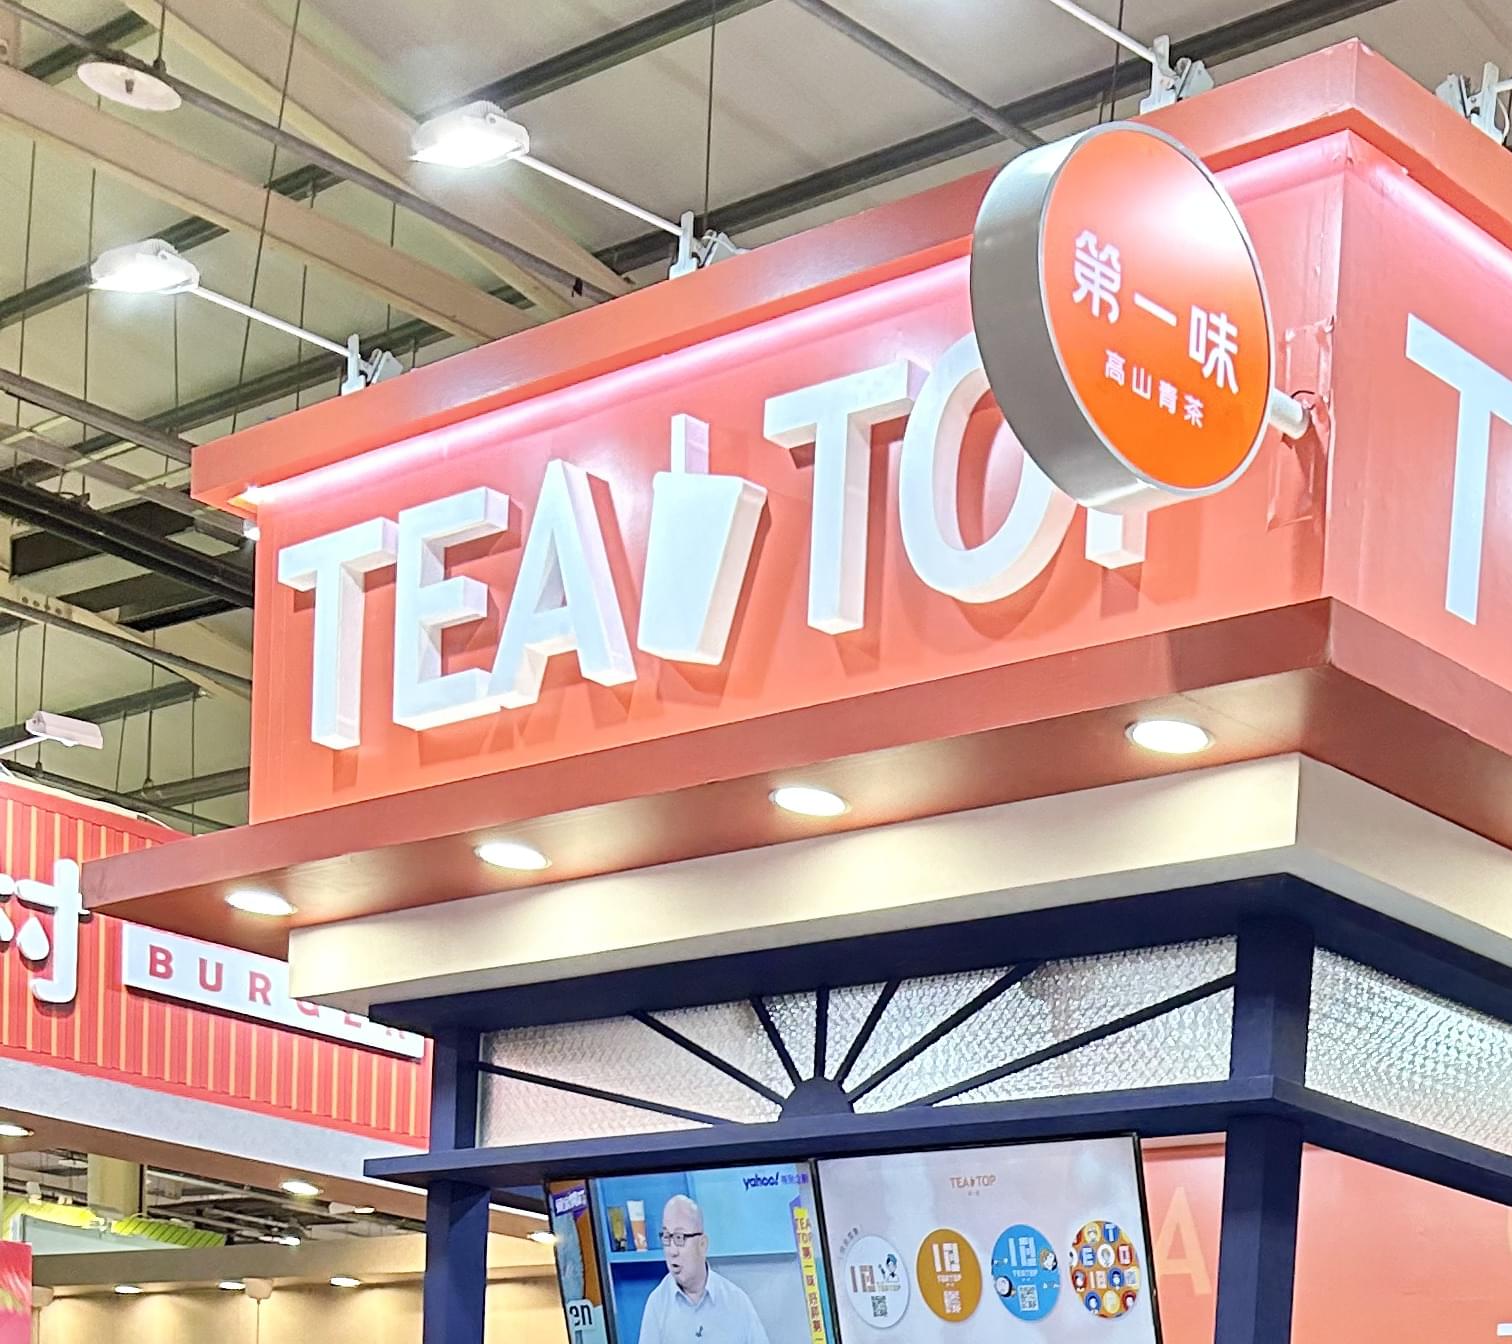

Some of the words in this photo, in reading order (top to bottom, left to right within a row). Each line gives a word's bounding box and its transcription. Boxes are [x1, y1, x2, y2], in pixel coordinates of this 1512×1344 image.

[1072, 229, 1240, 395] 第一味
[1103, 347, 1205, 430] 高山青茶
[278, 459, 638, 750] TEA
[764, 332, 1147, 634] TO
[743, 1172, 780, 1191] yahoo!
